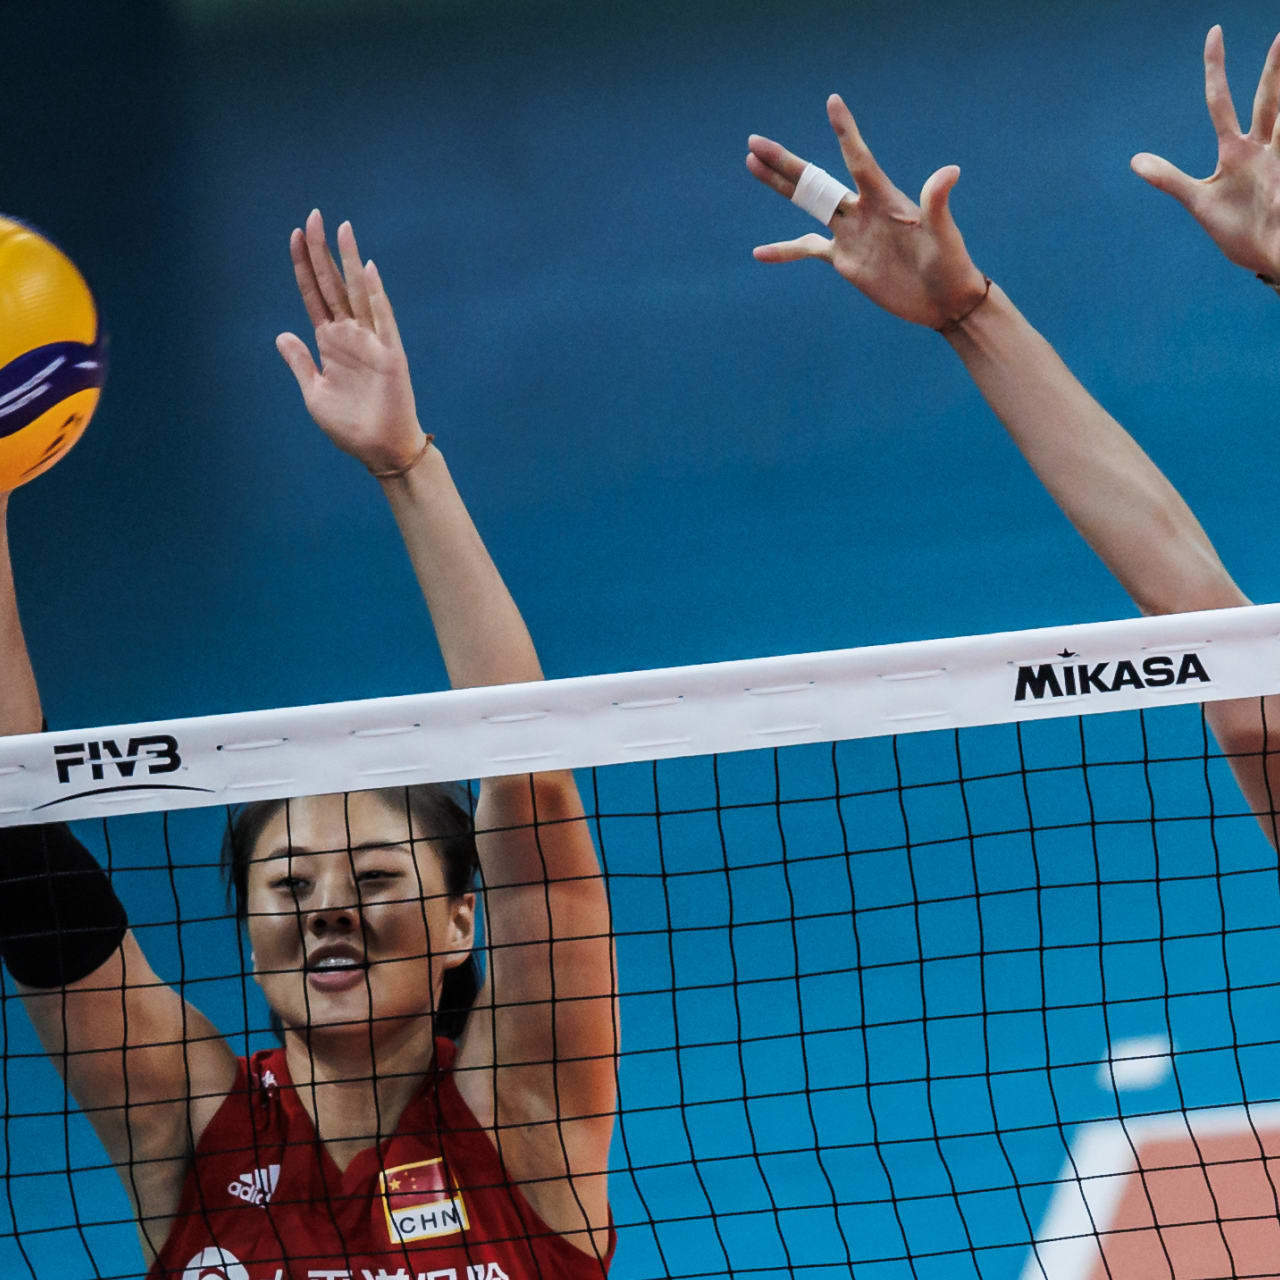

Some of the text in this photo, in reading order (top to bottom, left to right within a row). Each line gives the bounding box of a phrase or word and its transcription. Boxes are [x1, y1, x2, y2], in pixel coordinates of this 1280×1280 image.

[1014, 648, 1211, 702] MIKASA
[53, 735, 182, 784] FIVB
[399, 1208, 460, 1234] CHN
